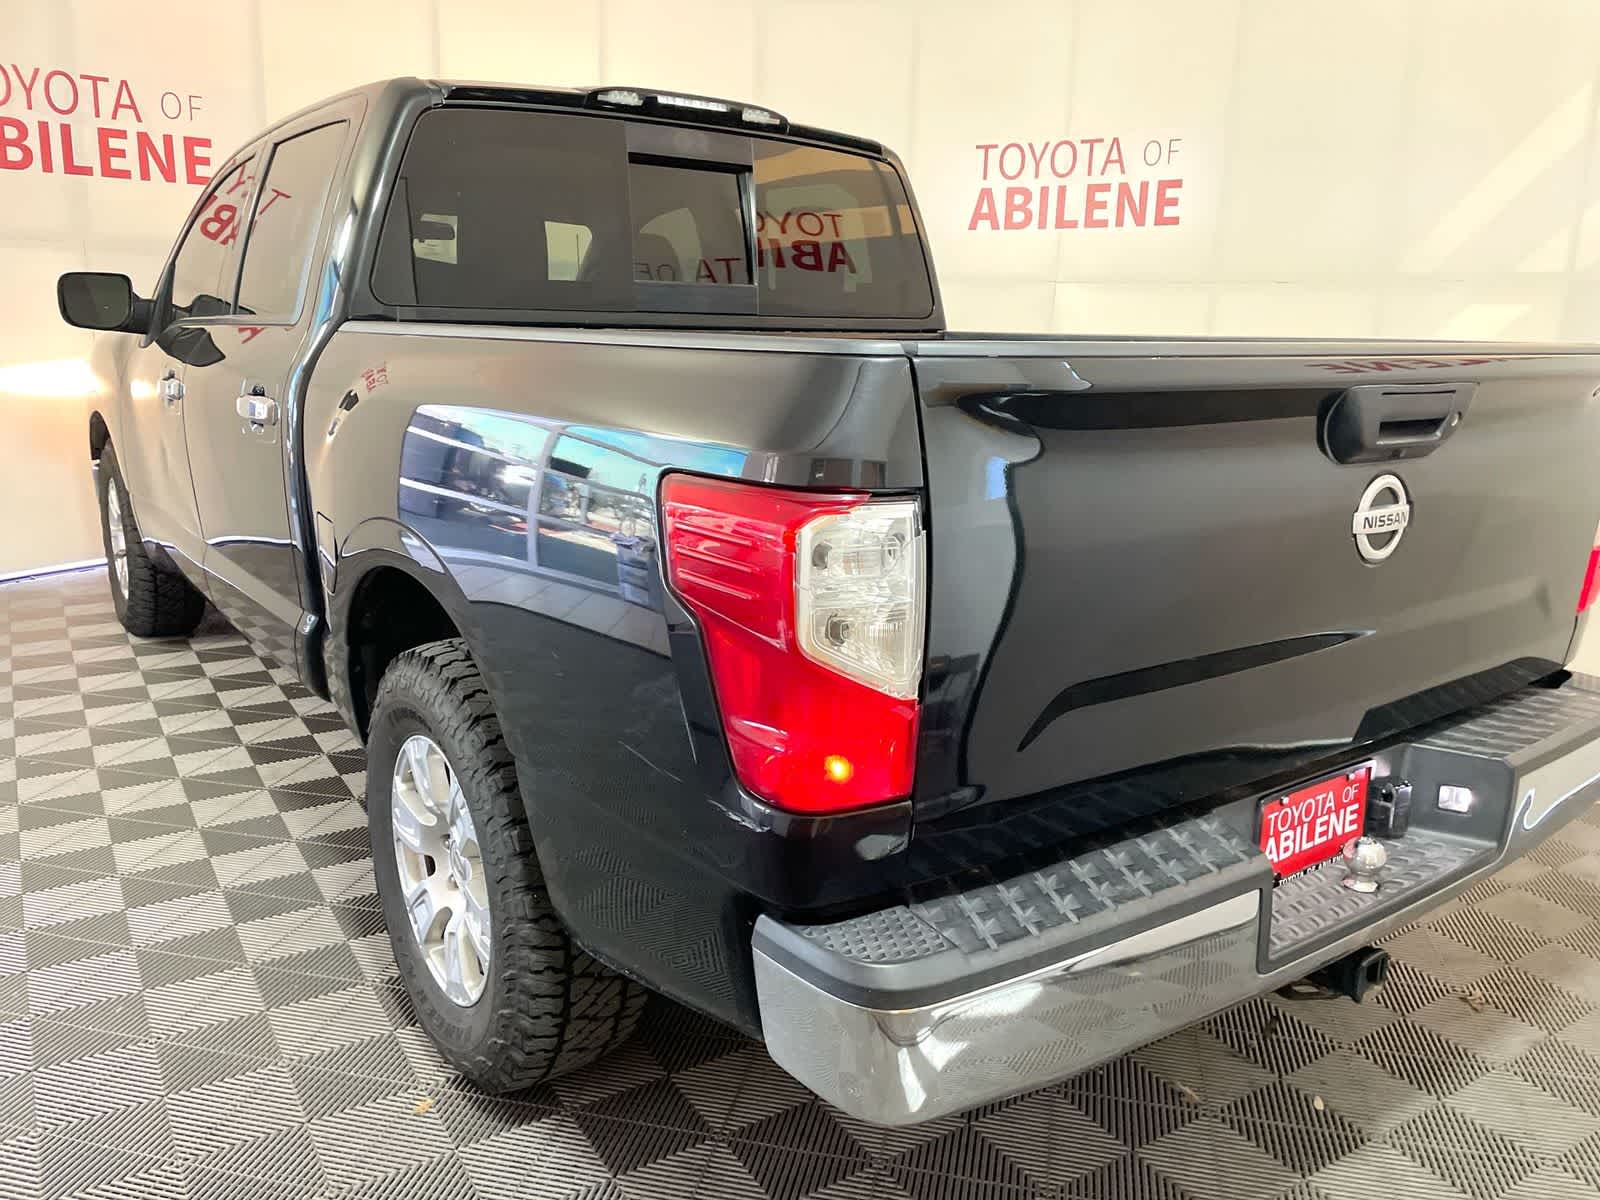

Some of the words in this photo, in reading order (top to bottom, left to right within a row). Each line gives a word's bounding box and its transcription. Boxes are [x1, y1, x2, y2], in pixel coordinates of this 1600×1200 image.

[161, 91, 203, 121] OF
[976, 137, 1125, 180] TOYOTA
[1144, 139, 1182, 166] OF
[968, 179, 1183, 230] ABILENE
[1363, 511, 1408, 529] NISSAN
[1265, 803, 1360, 863] ABILENE
[1268, 791, 1335, 836] TOYOTA
[1342, 783, 1360, 803] OF
